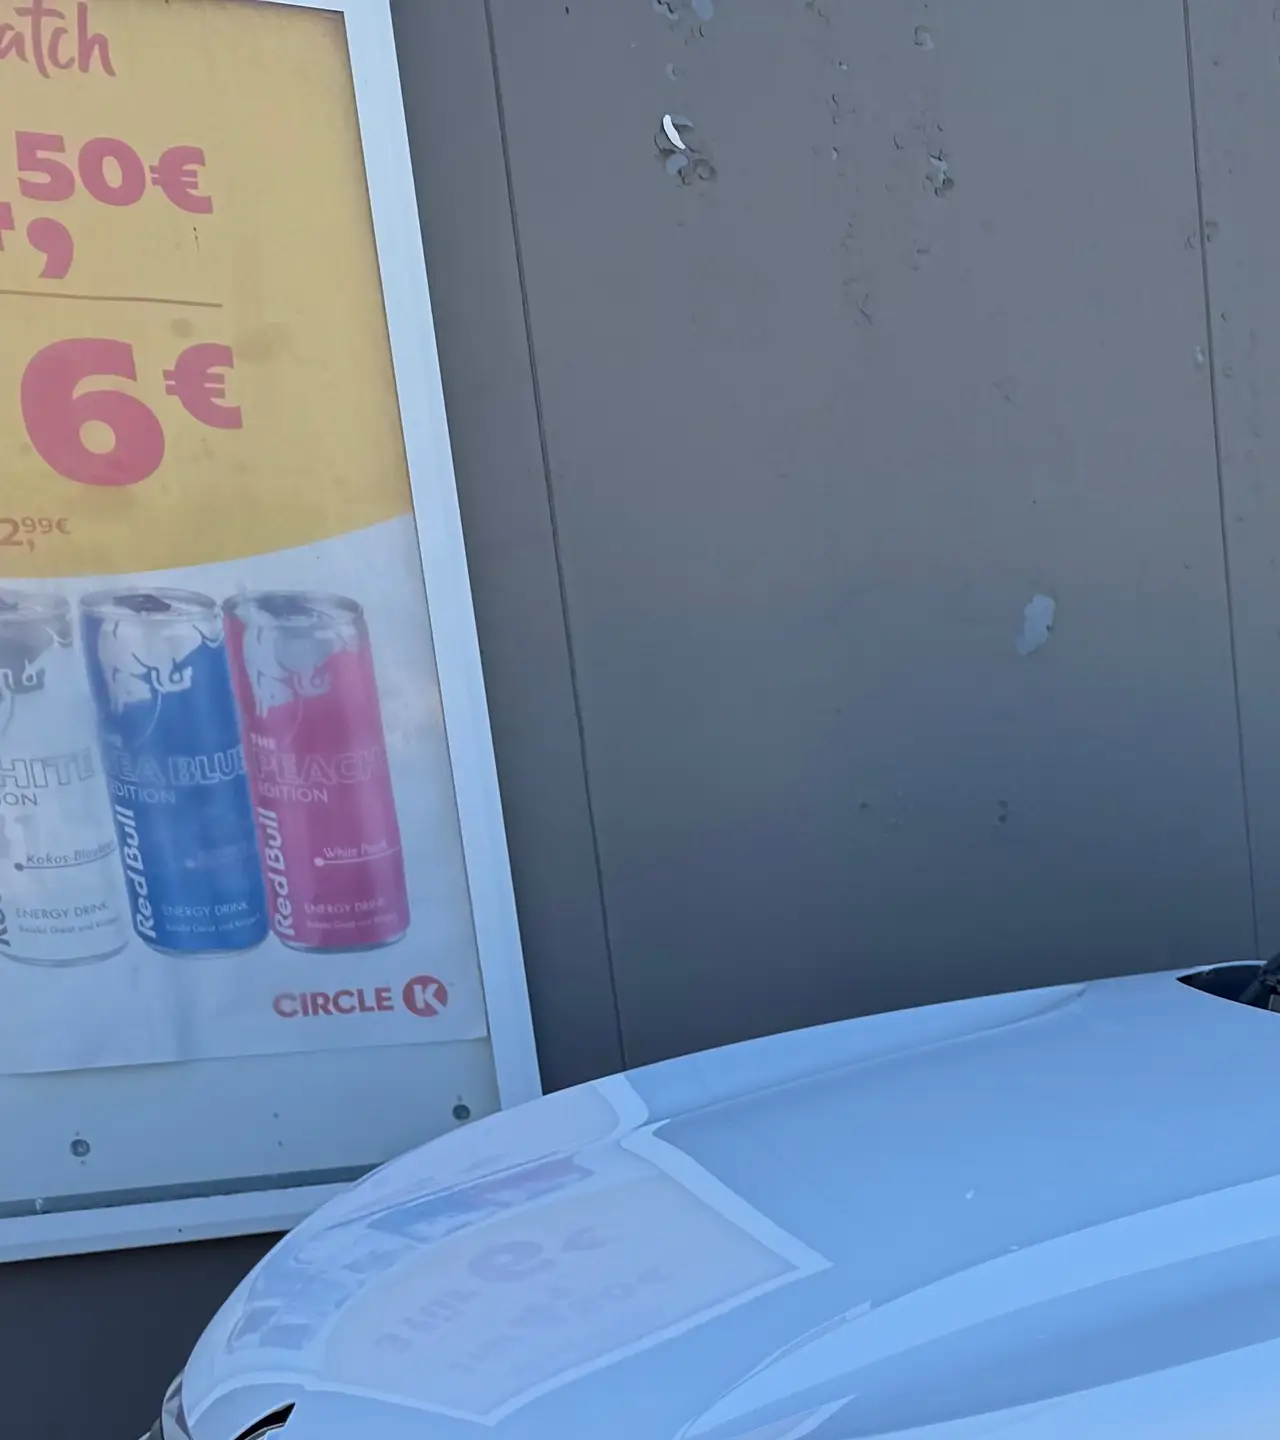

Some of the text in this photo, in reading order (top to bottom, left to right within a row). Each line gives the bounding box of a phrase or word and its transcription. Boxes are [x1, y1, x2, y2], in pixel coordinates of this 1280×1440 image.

[257, 780, 328, 804] EDITION
[115, 803, 145, 871] Bull
[256, 806, 285, 872] Bull
[15, 902, 109, 920] ENERGY DRINK
[272, 979, 447, 1019] CIRCLE K
